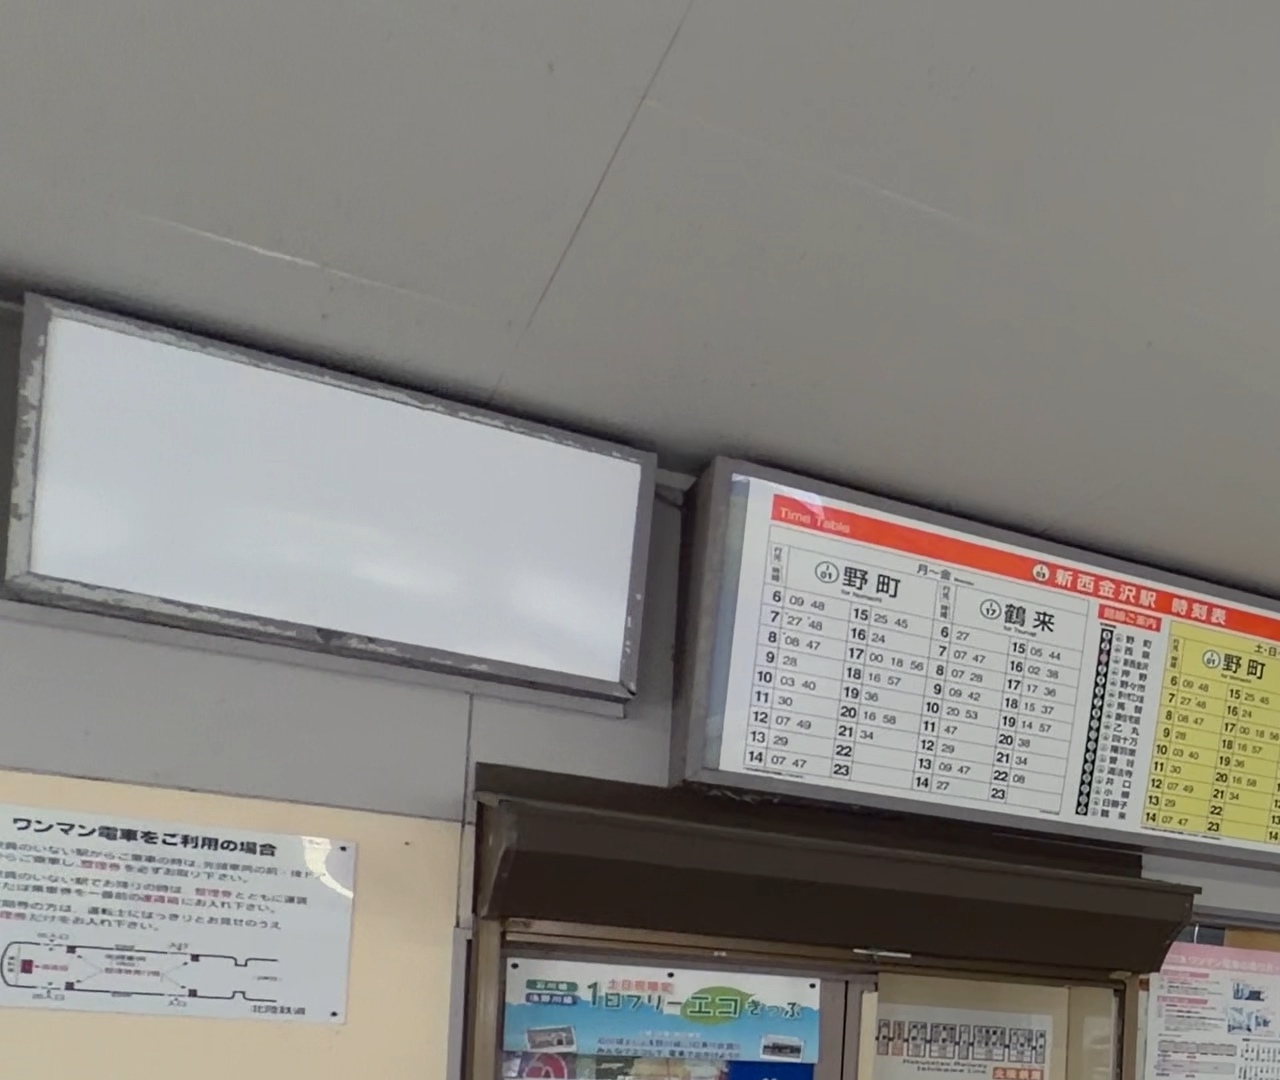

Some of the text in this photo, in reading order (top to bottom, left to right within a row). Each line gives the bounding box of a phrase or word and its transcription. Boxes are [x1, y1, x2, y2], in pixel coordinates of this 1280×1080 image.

[780, 507, 850, 534] Time Table
[820, 571, 833, 580] 01
[843, 566, 901, 598] 野町
[773, 591, 825, 611] 6 09 48
[1055, 568, 1226, 625] 新西金沢駅 時刻表
[770, 611, 823, 631] 7 27 48
[1004, 603, 1055, 632] 鶴来
[768, 631, 777, 643] 8
[806, 639, 821, 650] 47
[766, 652, 797, 667] 9 28
[1222, 653, 1266, 681] 野町
[12, 817, 278, 857] ワンマン電車をご利用の場合
[252, 1004, 306, 1016] 北陸鉄道
[587, 982, 801, 1018] 1日フリーエコきっぷ
